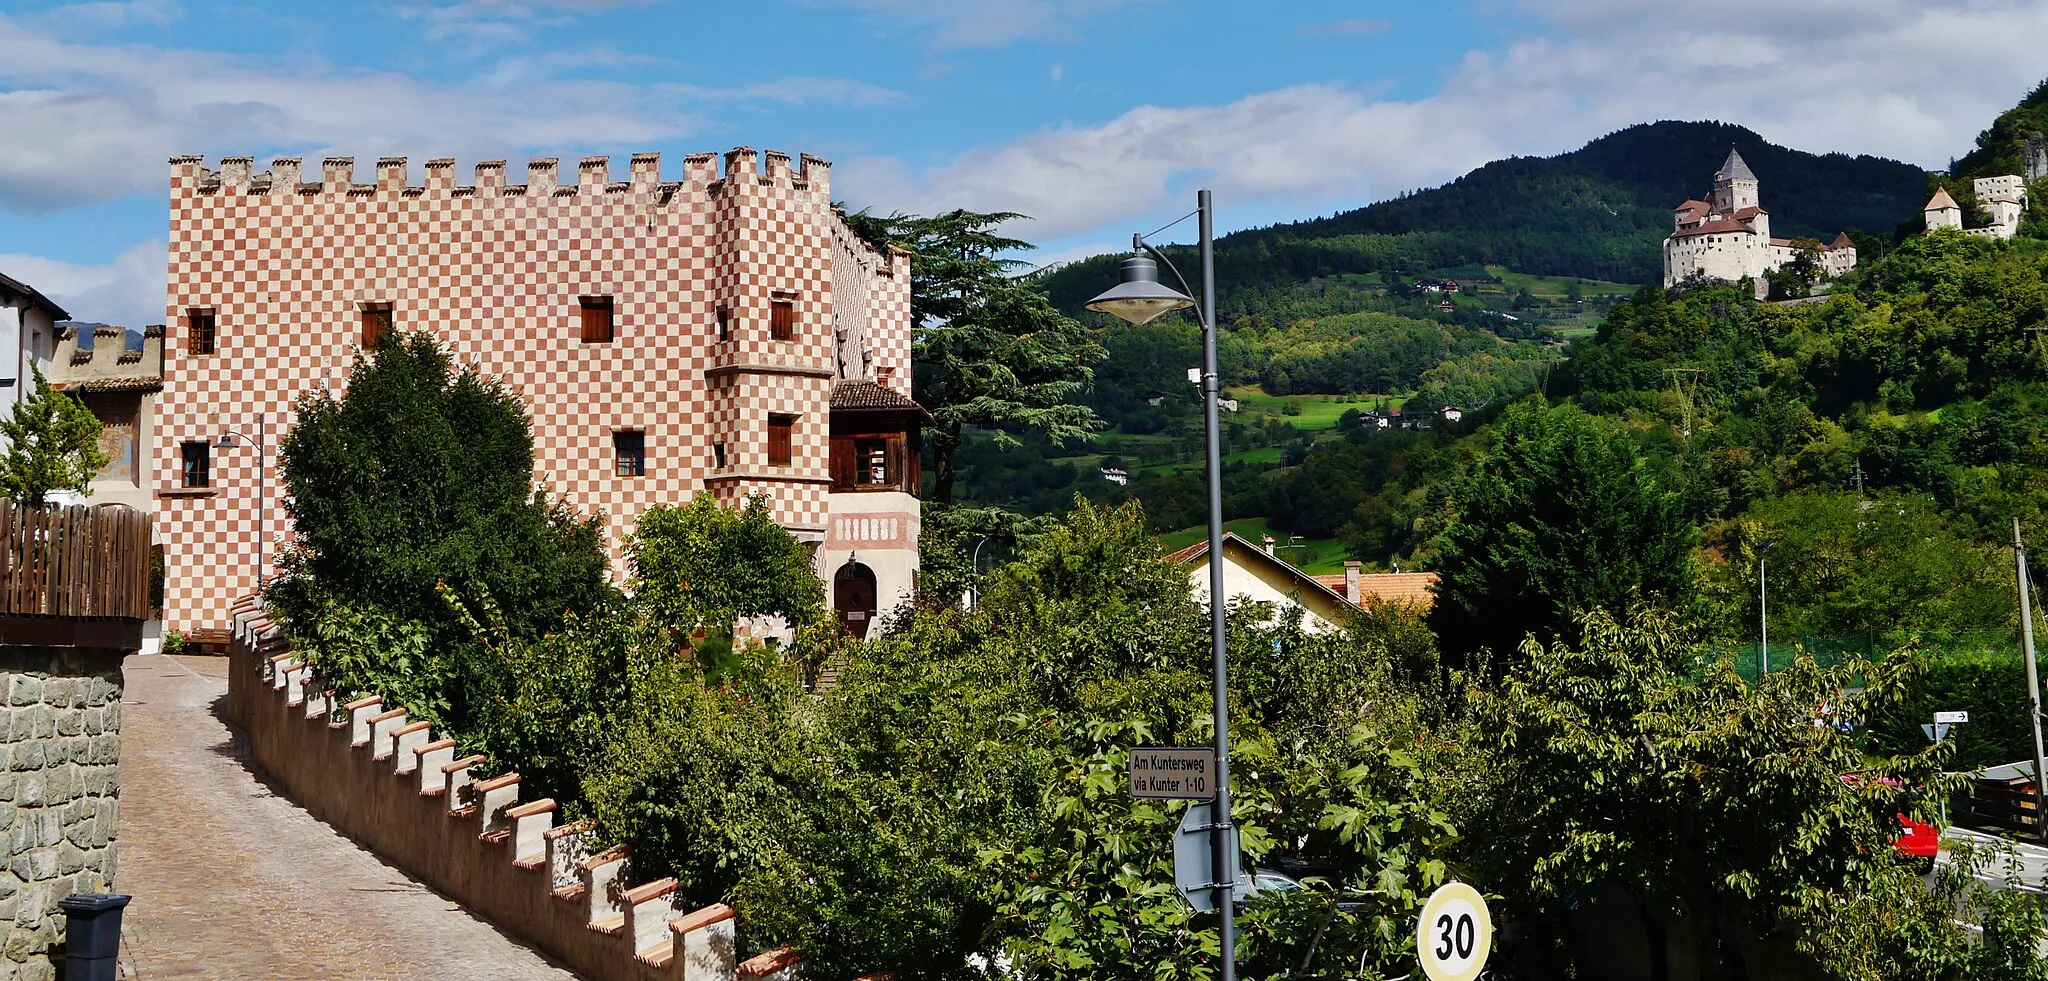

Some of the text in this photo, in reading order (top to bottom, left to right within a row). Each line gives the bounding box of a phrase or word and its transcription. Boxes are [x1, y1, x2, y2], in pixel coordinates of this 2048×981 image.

[1134, 755, 1205, 773] Am Kuntersweg
[1134, 776, 1205, 792] via Kunter 1-10
[1436, 913, 1474, 960] 30
